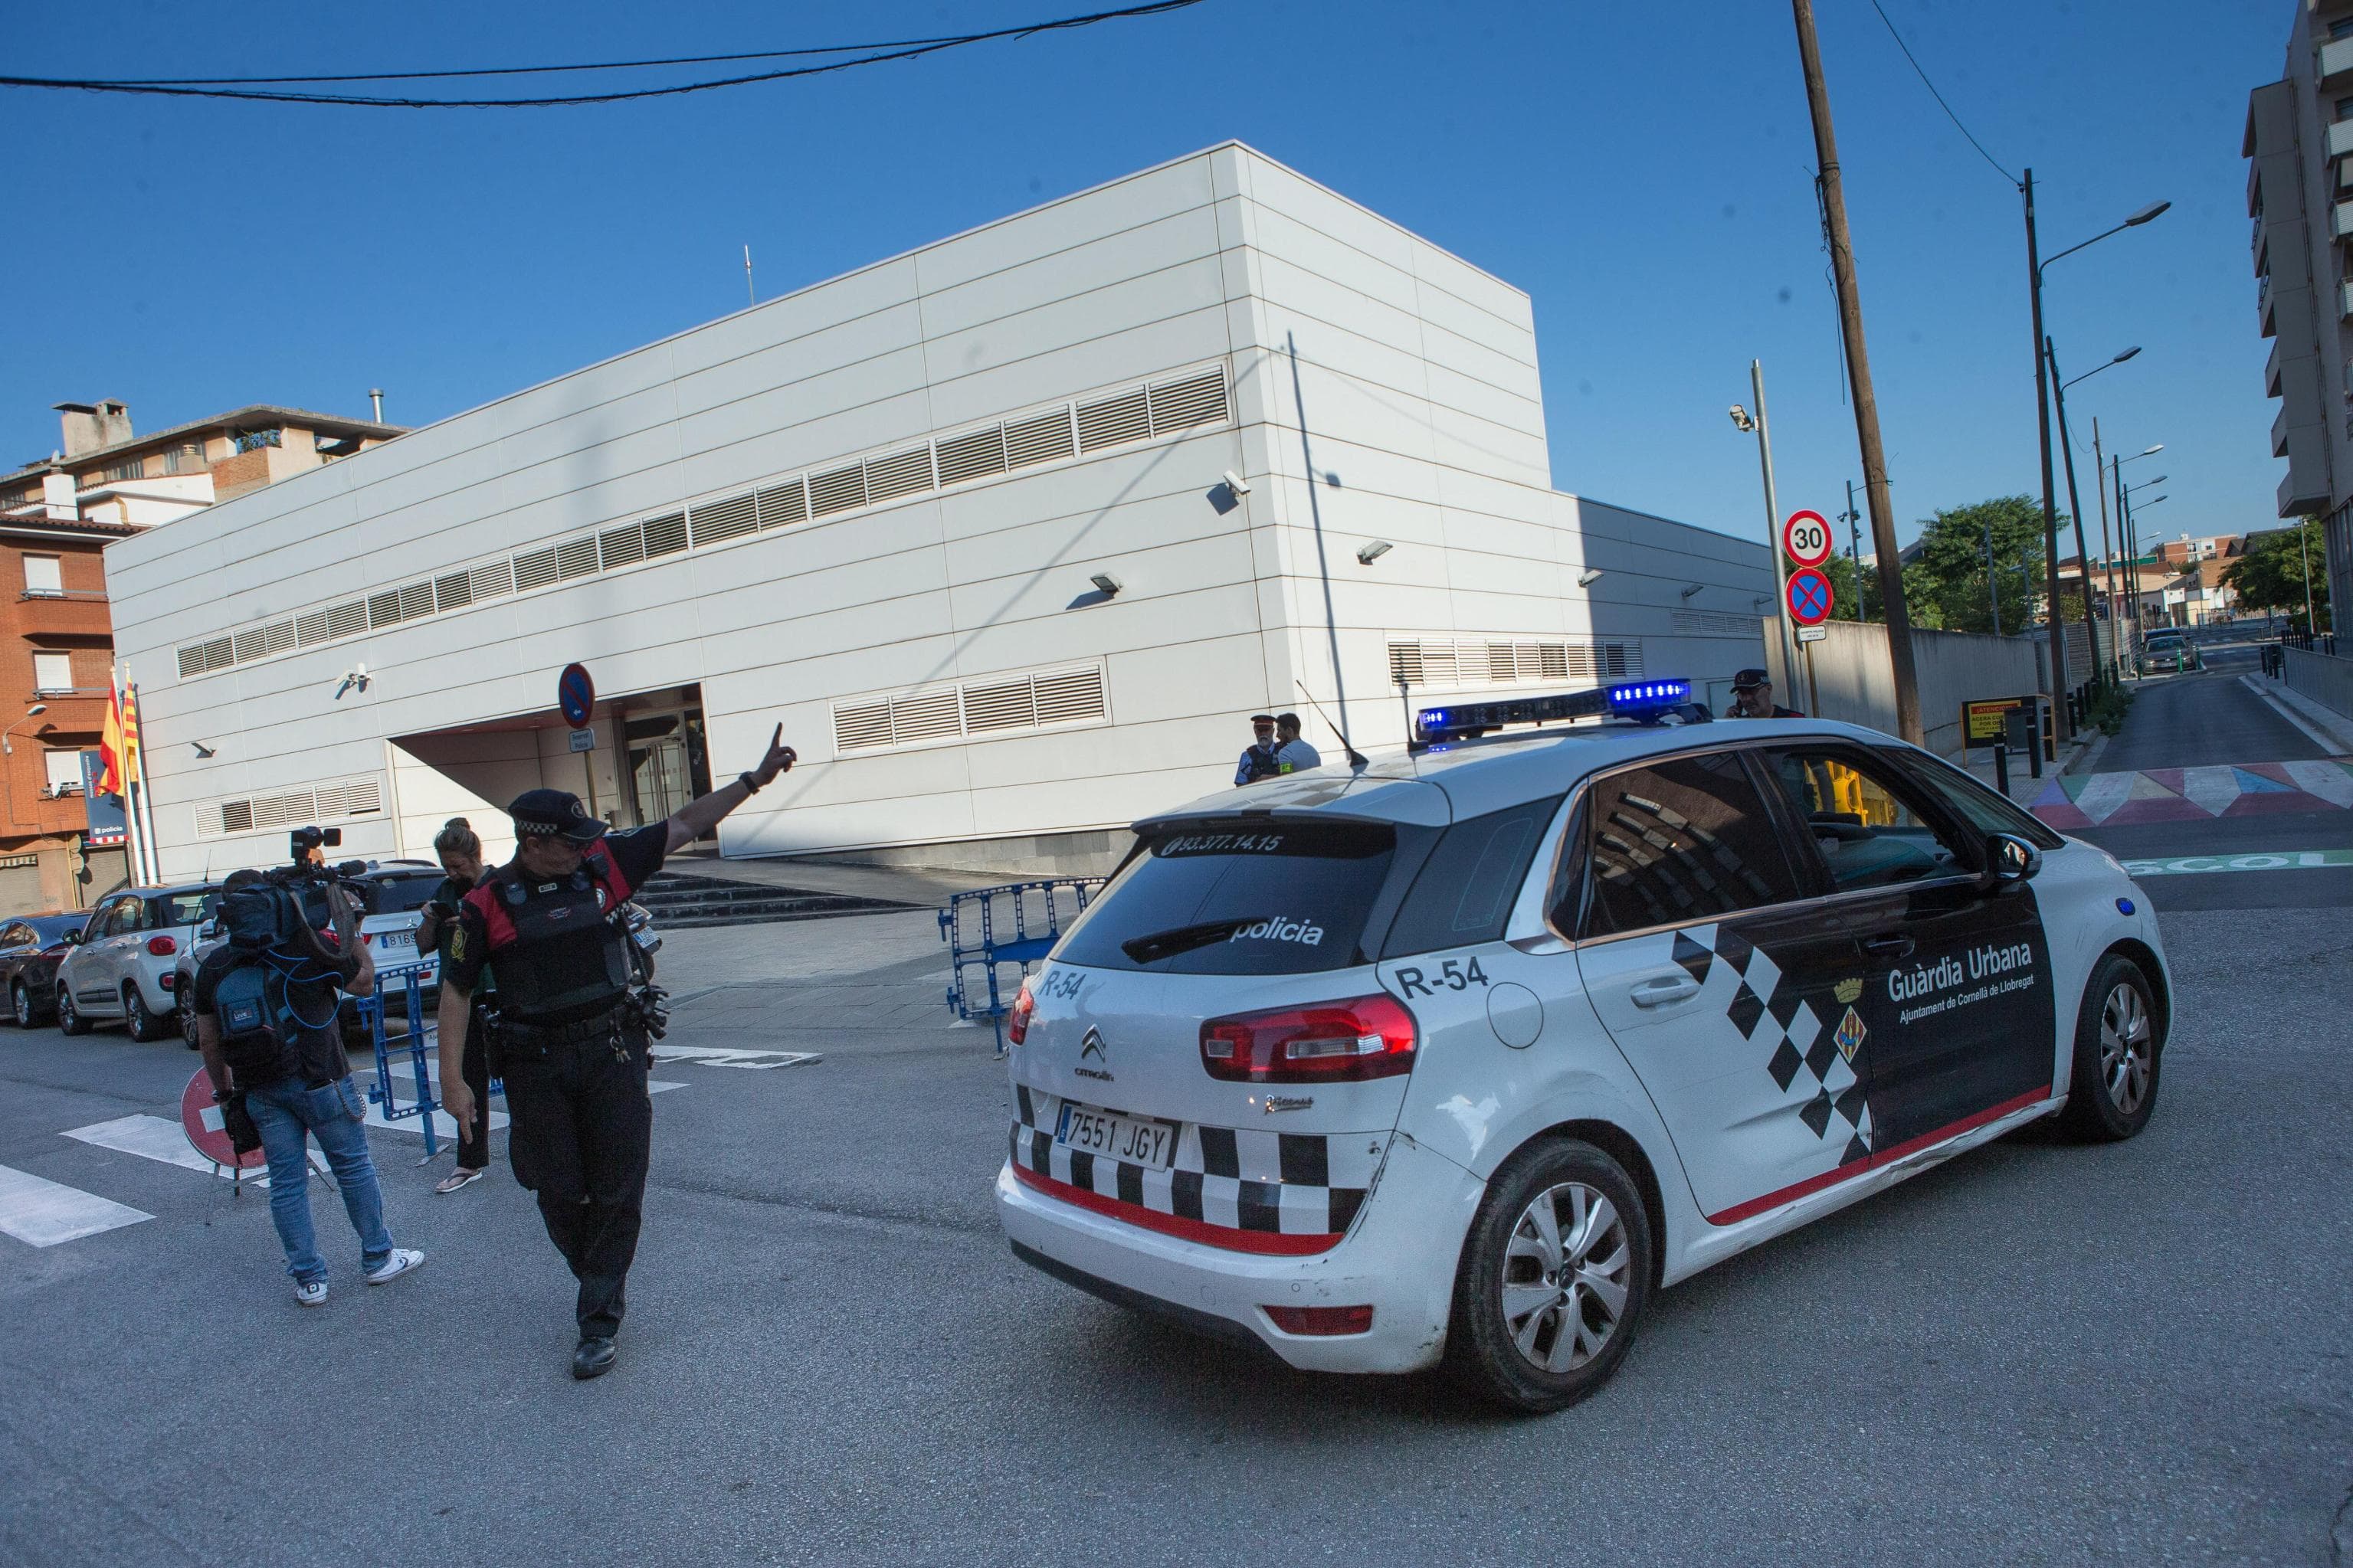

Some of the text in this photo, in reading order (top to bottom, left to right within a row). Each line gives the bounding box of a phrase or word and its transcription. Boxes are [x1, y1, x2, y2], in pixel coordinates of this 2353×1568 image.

[1794, 527, 1822, 550] 30
[1178, 833, 1284, 852] 93.377.14.15
[1229, 916, 1324, 946] policia
[1039, 970, 1087, 1000] R-54
[1394, 955, 1489, 1000] R-54
[1888, 943, 2033, 1002] Guàrdia Urbana
[1899, 974, 2034, 1025] Ajuntament de Cornellà de Llobregat
[1069, 1111, 1166, 1164] 7551 JGY
